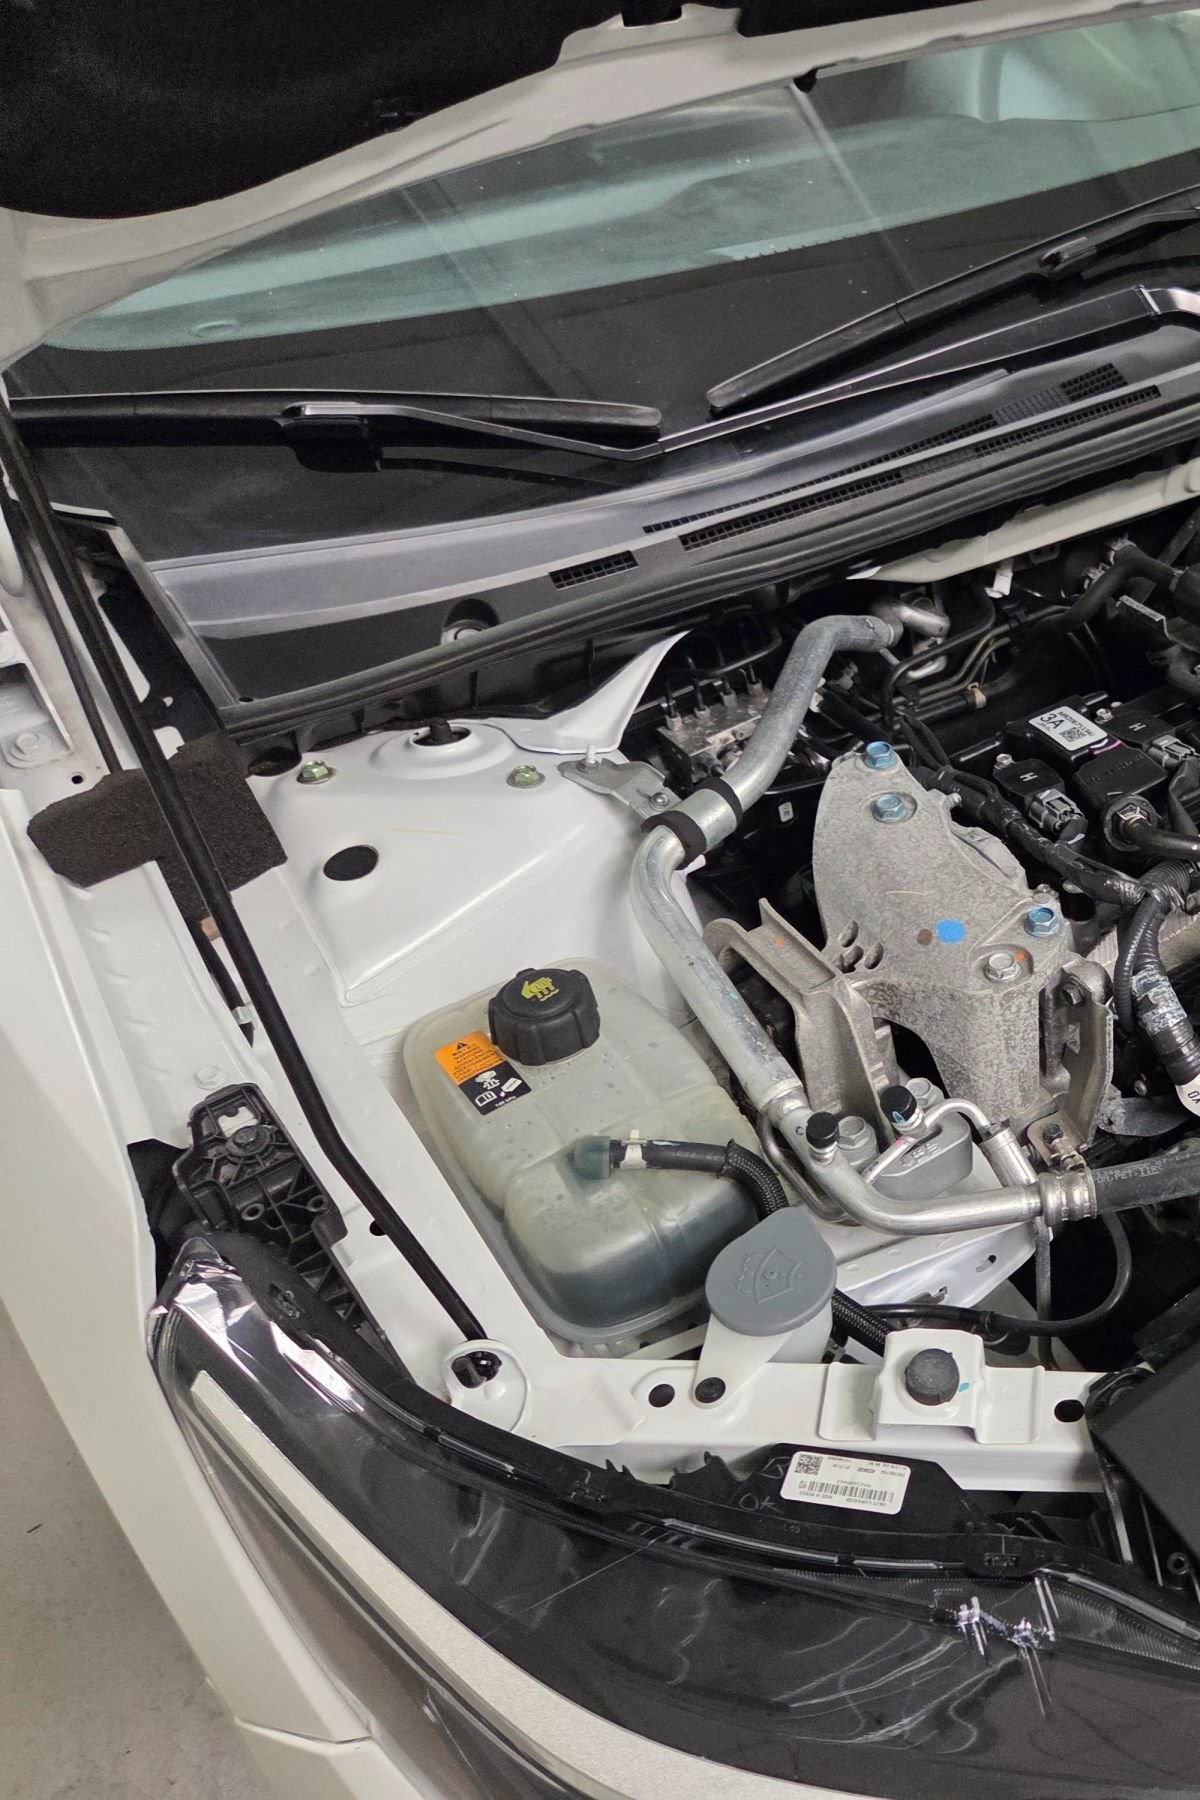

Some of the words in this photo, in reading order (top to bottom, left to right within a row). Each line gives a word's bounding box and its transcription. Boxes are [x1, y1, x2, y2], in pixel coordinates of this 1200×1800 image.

[1040, 713, 1065, 729] 3A
[1129, 722, 1147, 732] H
[1019, 772, 1039, 782] H
